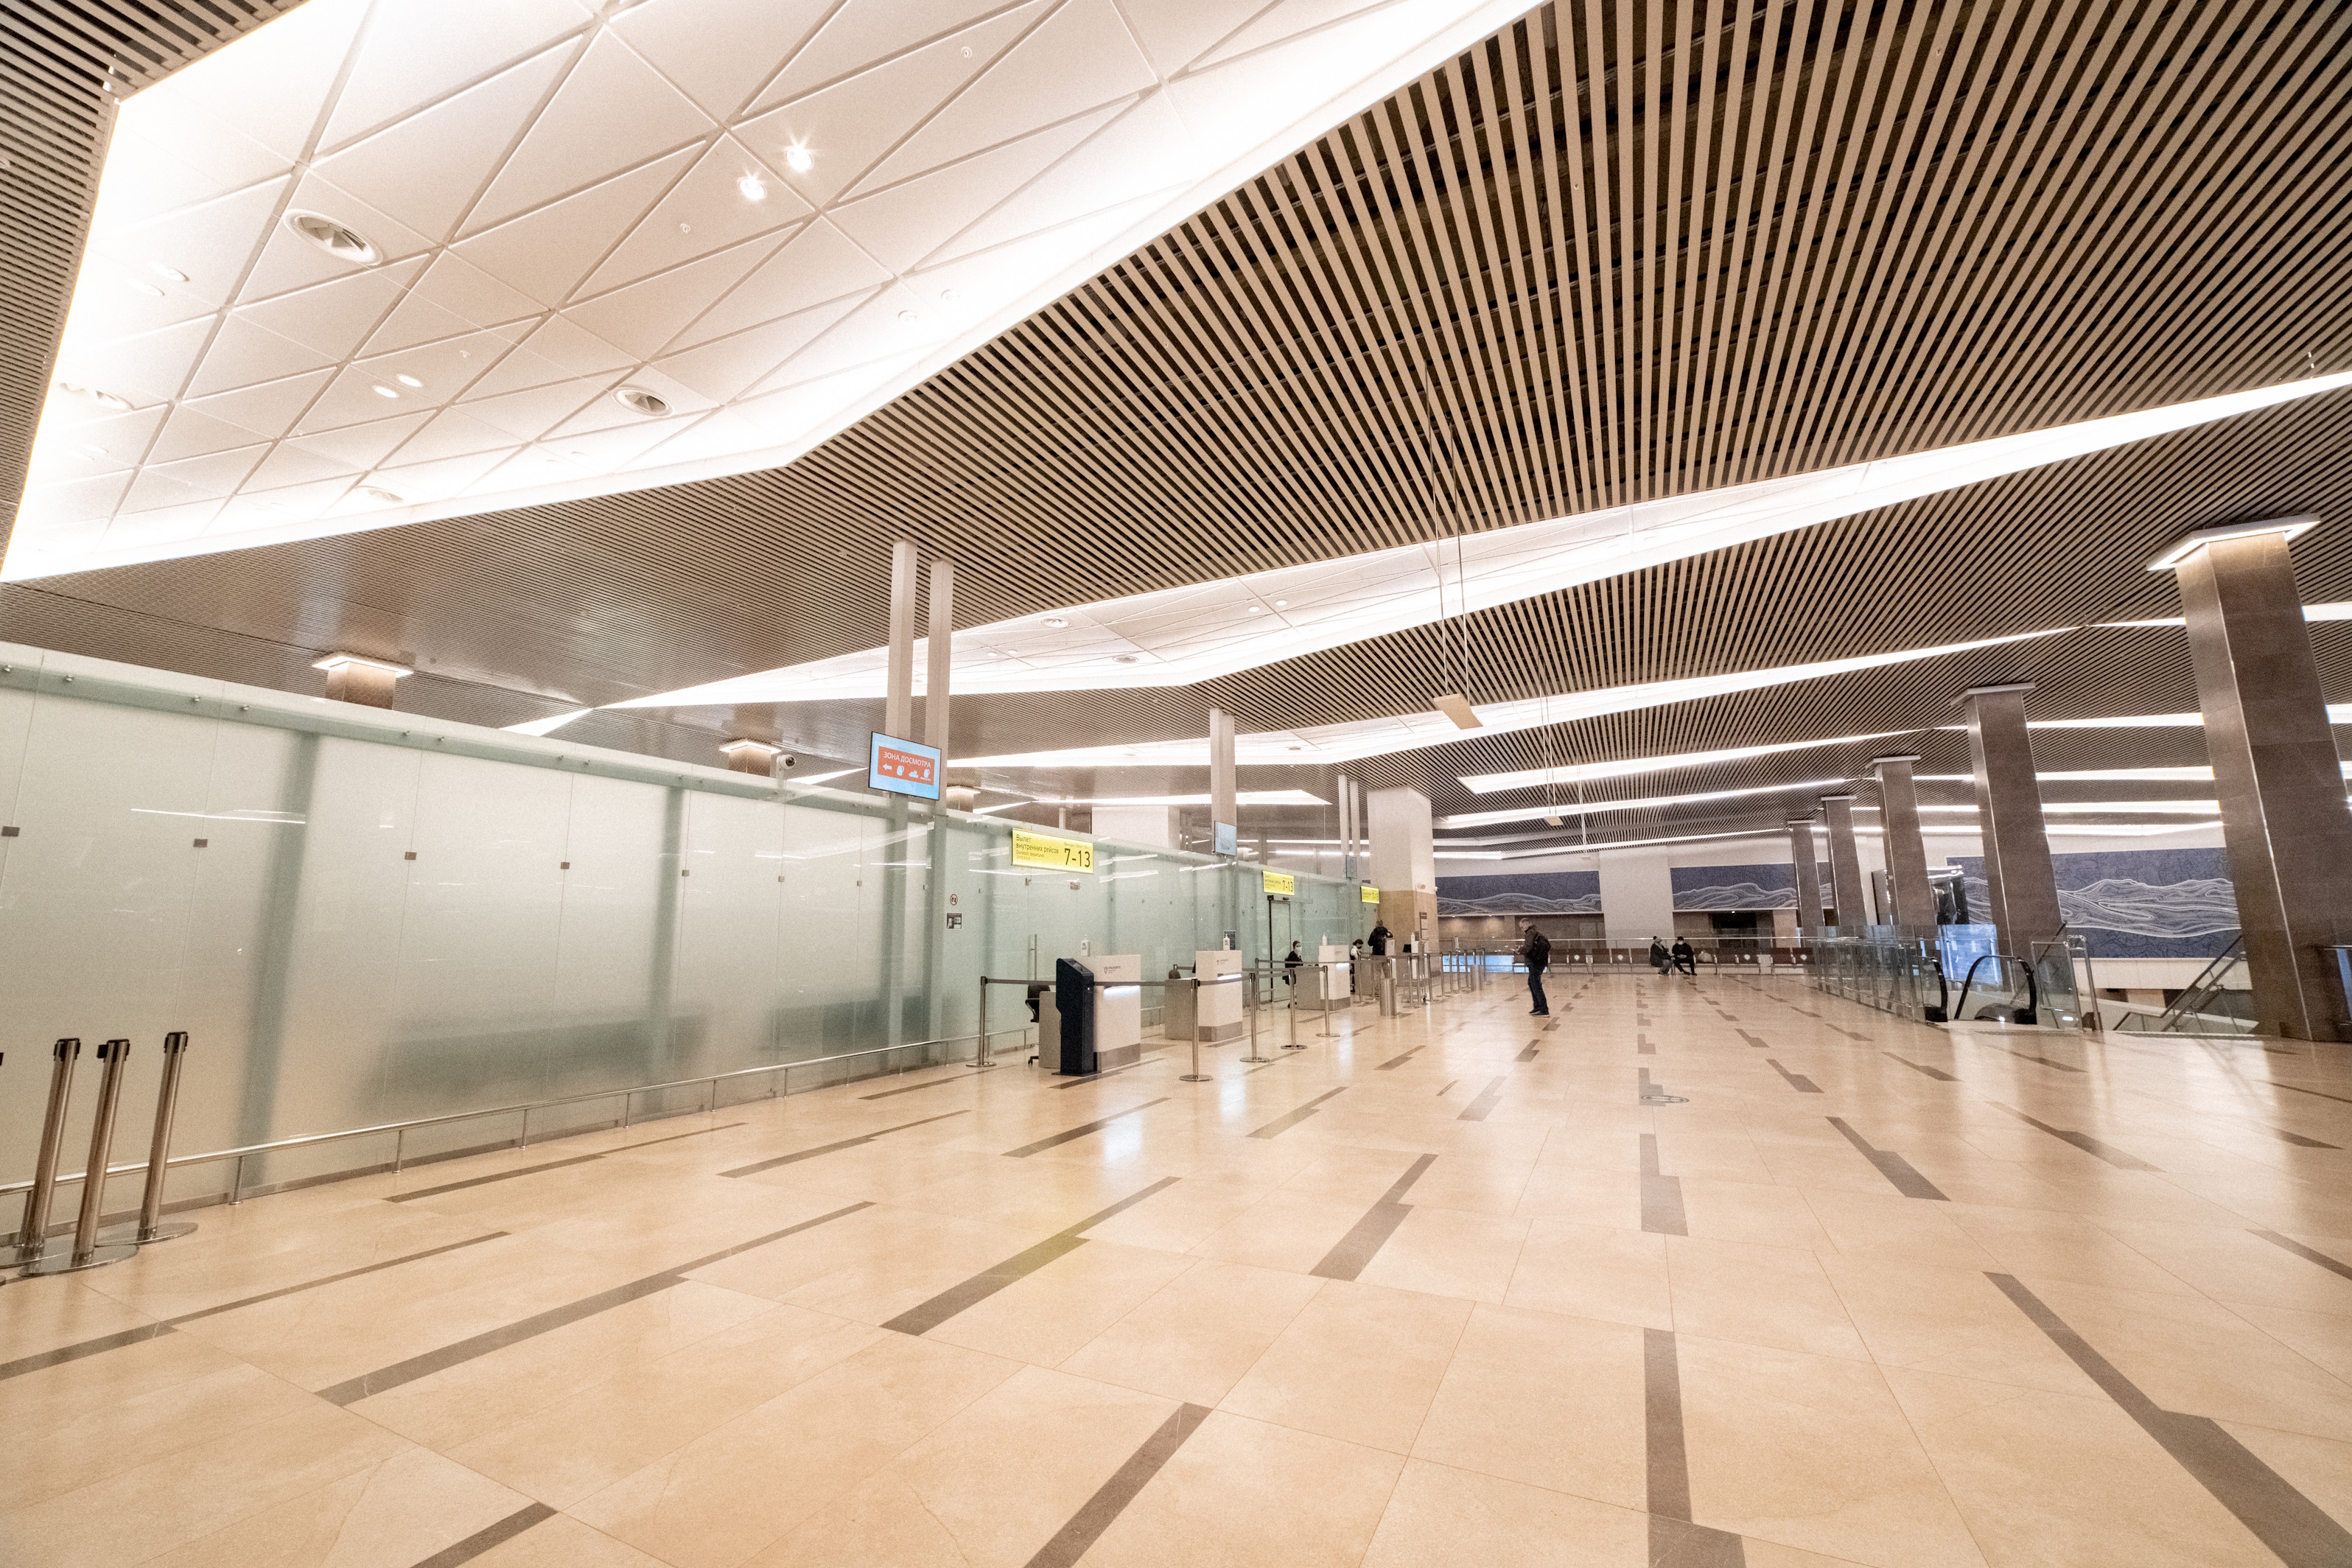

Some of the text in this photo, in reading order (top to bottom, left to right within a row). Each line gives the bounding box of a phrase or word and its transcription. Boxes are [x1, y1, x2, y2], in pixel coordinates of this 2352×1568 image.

[884, 752, 931, 769] ЗОНА ДОСМОТРА
[1016, 834, 1031, 842] Вылет
[1016, 843, 1043, 852] внутренних
[1064, 848, 1091, 868] 7-13
[1282, 880, 1293, 892] 7-13
